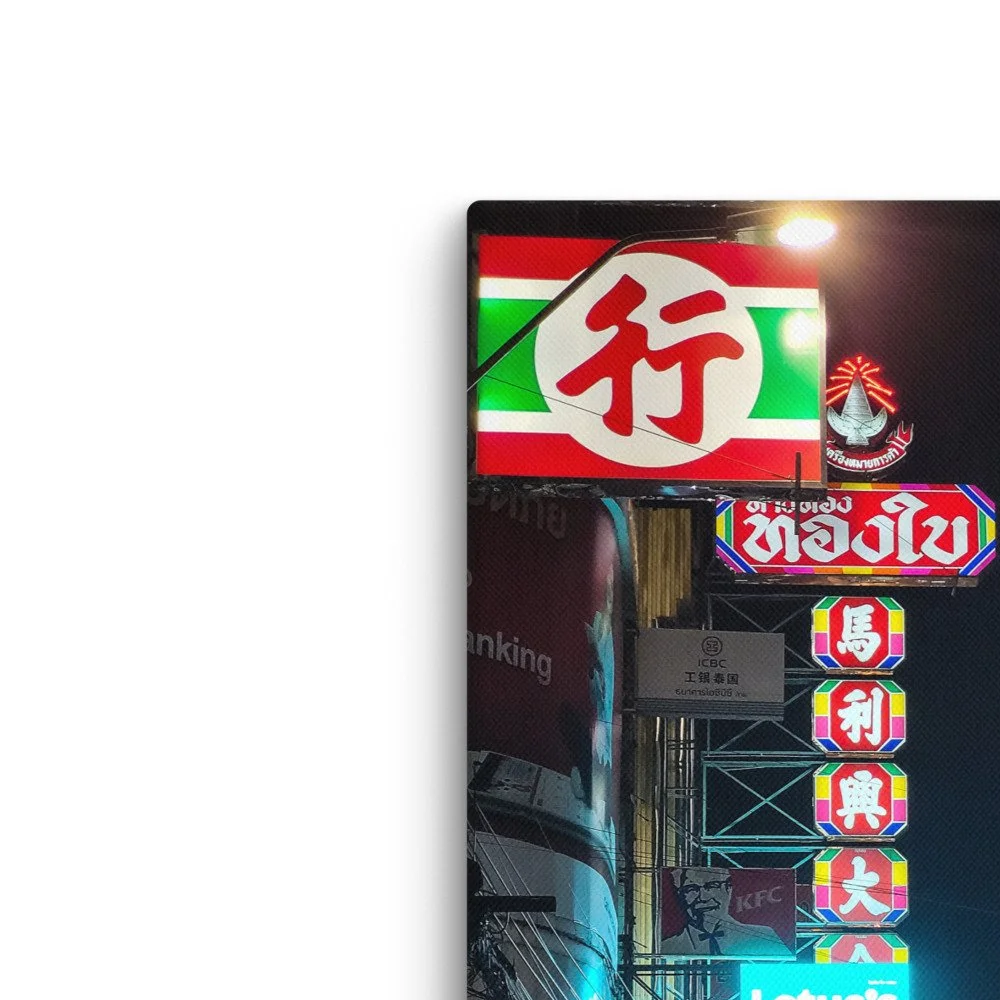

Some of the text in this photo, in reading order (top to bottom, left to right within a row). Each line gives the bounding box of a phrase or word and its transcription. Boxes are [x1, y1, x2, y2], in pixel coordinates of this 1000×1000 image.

[556, 272, 744, 445] 行
[826, 447, 900, 469] ครื่องหมายการค้า
[742, 492, 970, 565] ทองใบ
[684, 671, 739, 685] 工银泰国
[698, 659, 727, 669] ICBC
[836, 604, 891, 963] 馬利興大
[735, 885, 783, 914] KFC
